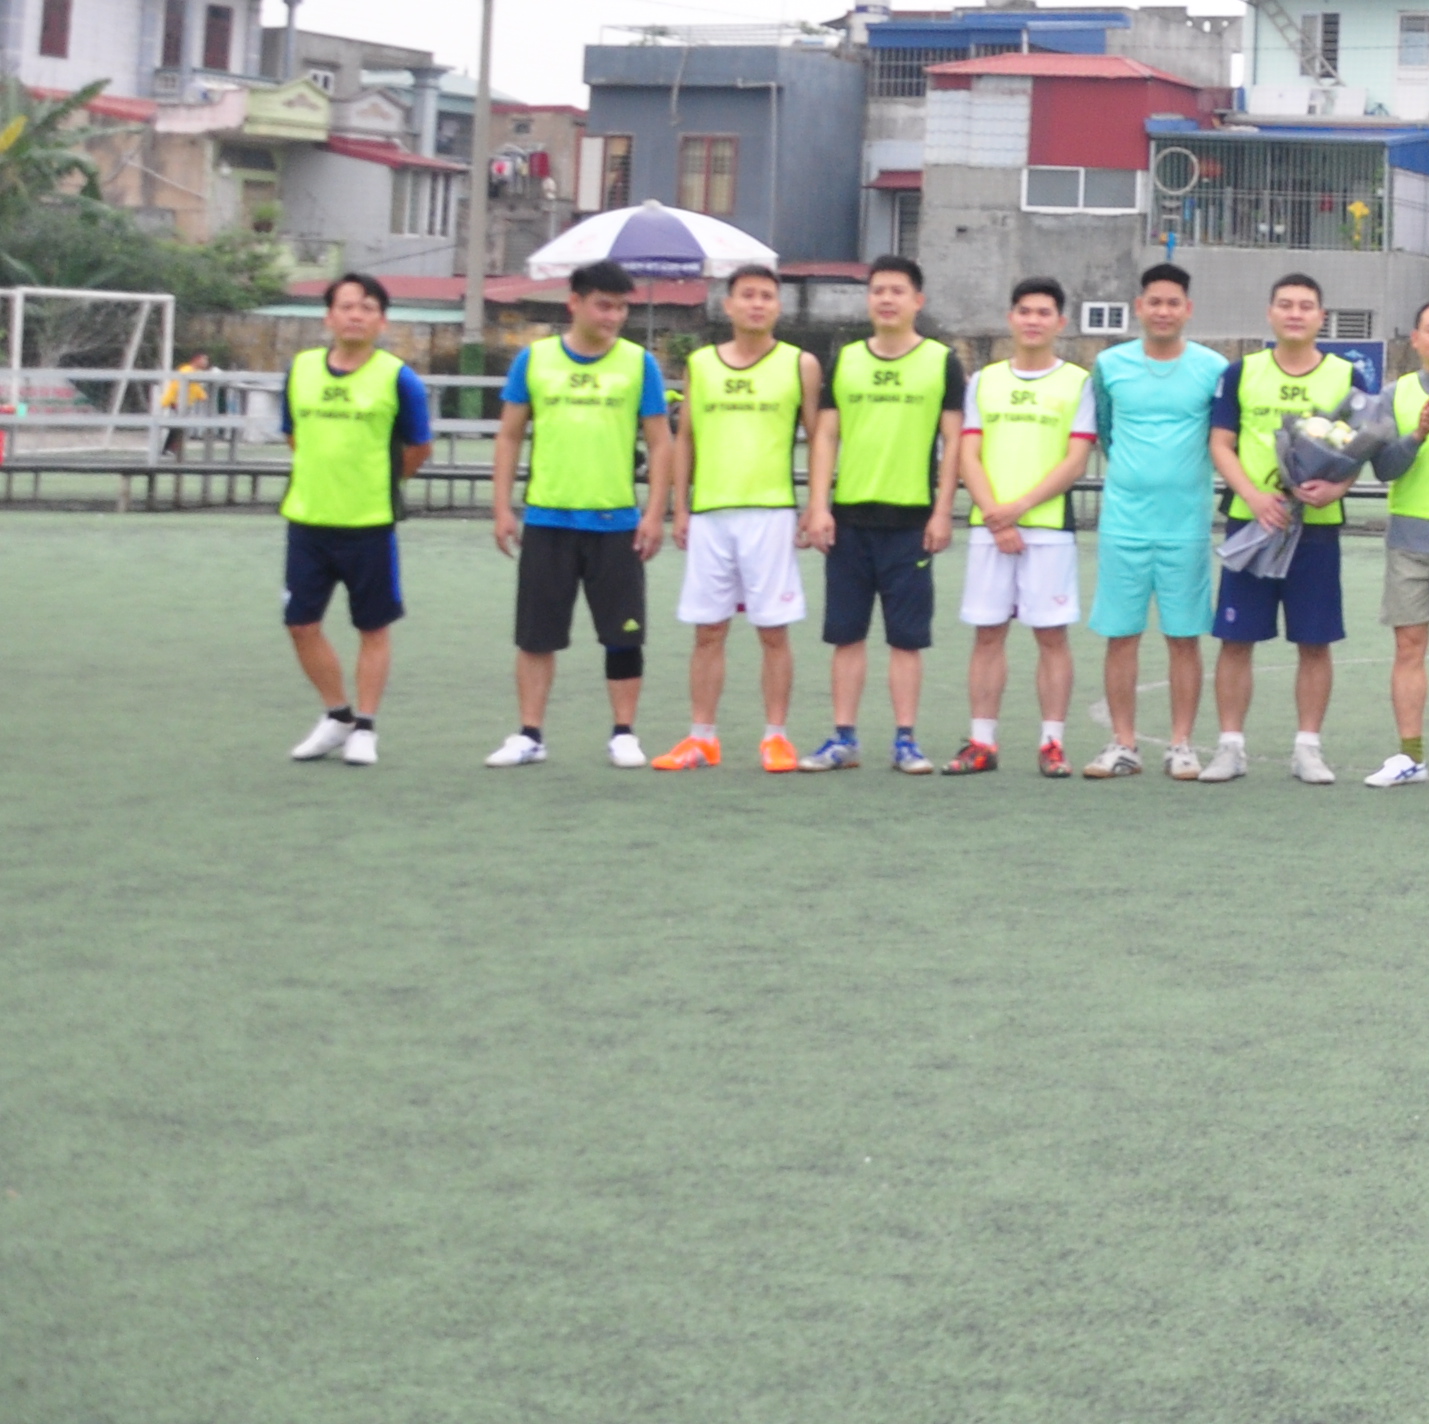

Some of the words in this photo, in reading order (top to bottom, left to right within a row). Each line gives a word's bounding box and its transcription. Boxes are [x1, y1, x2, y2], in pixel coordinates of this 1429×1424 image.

[570, 373, 600, 389] SPL
[873, 370, 901, 386] SPL
[725, 379, 755, 394] SPL
[1280, 385, 1310, 402] SPL
[1010, 390, 1037, 405] SPL
